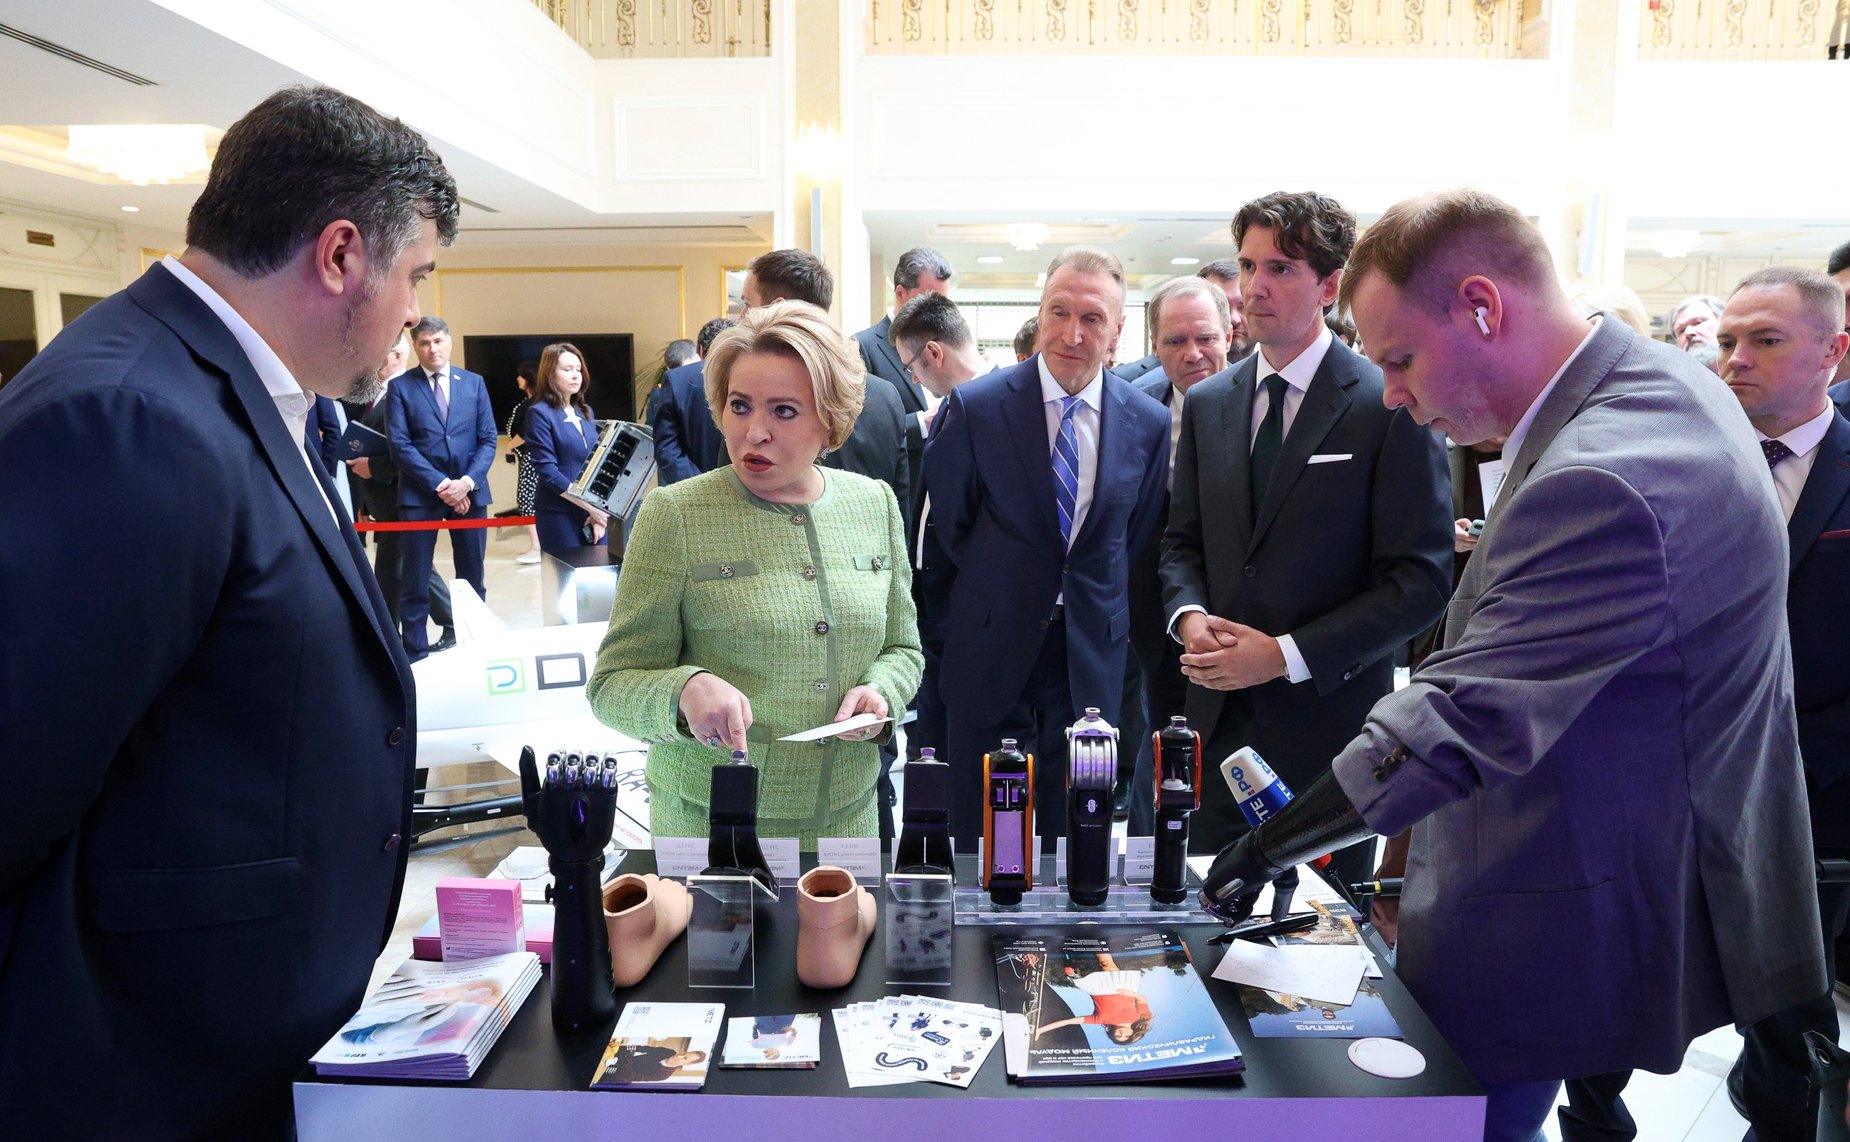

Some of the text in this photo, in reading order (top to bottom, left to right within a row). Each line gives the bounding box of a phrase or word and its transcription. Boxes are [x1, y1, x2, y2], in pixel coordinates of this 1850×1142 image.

[1029, 1035, 1216, 1056] ГИДРАВЛИЧЕСКИЙ КОЛЕННЫЙ МОДУЛЬ
